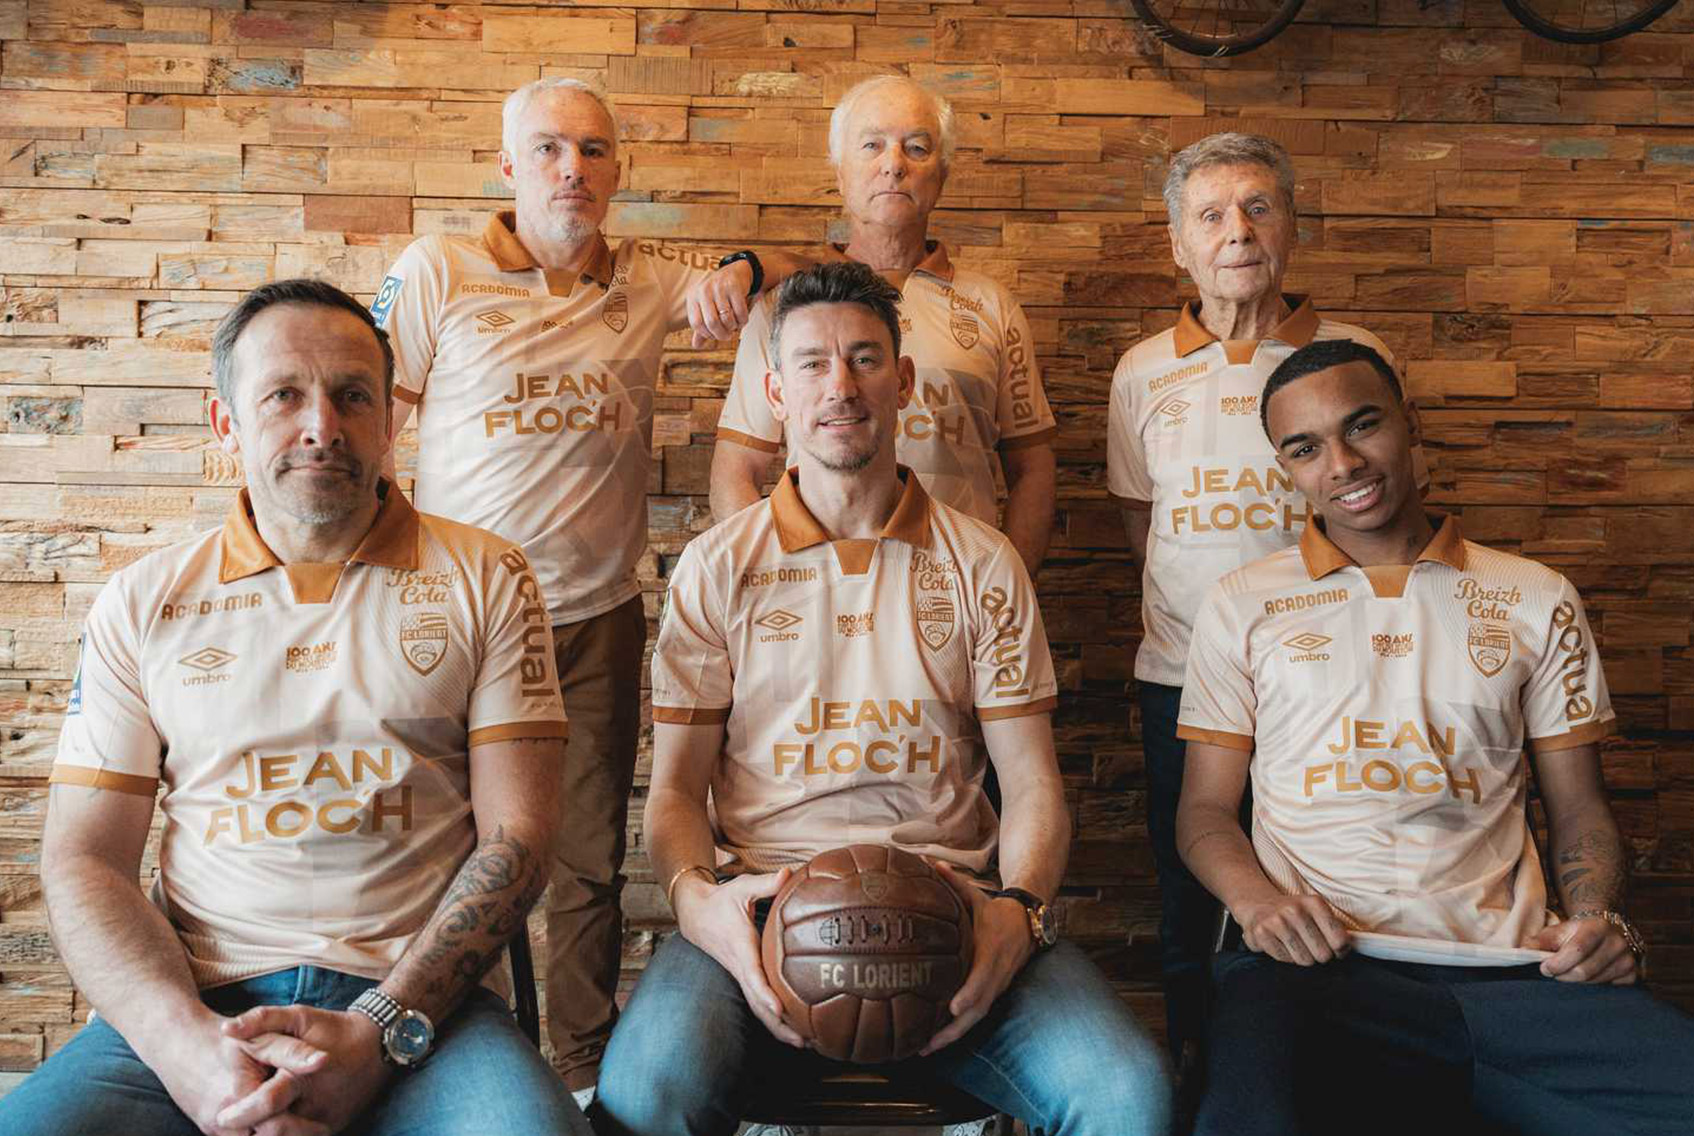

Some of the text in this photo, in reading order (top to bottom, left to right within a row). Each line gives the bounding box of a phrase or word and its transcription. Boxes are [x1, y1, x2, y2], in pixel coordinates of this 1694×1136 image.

[639, 241, 720, 272] actua
[461, 283, 530, 298] ACADOMIA
[504, 372, 609, 404] JEAN
[1006, 326, 1039, 430] actual
[1148, 361, 1208, 393] ACADOMIA
[485, 399, 621, 438] FLOC'H
[1181, 466, 1295, 499] JEAN
[741, 566, 818, 588] ACADOMIA
[1454, 578, 1522, 606] Breizh
[161, 592, 263, 621] ACADOMIA
[1264, 588, 1349, 616] ACADOMIA
[1467, 600, 1509, 622] Cola
[501, 548, 556, 698] actual
[760, 630, 800, 643] umbro
[981, 586, 1031, 699] actual
[1289, 651, 1331, 664] umbro
[1553, 600, 1594, 722] actua
[182, 672, 232, 688] umbro
[794, 696, 922, 736] JEAN
[1327, 716, 1456, 756] JEAN
[773, 734, 942, 776] FLOC'H
[226, 747, 392, 798] JEAN
[820, 962, 933, 989] FC LORIENT
